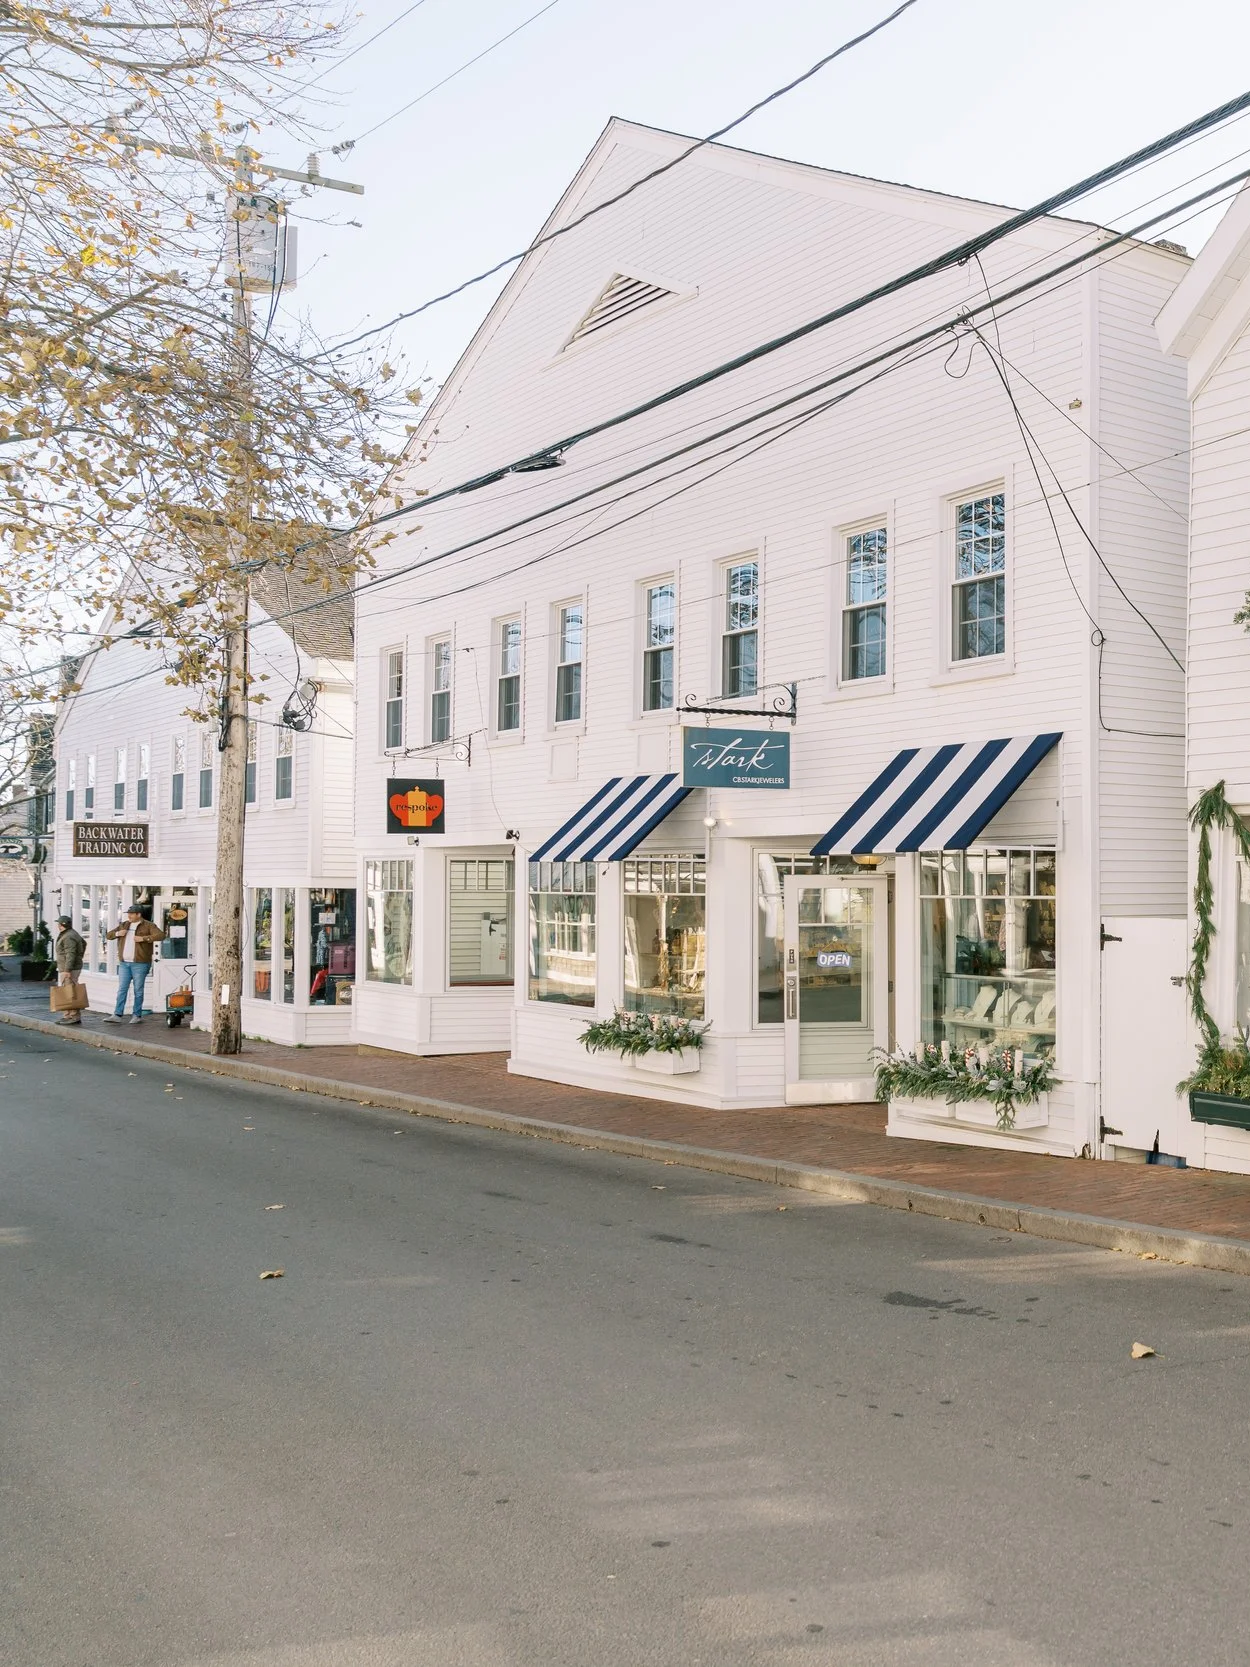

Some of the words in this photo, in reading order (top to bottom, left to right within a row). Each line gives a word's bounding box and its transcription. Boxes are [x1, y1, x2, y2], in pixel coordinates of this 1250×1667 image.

[396, 802, 438, 814] respoke
[78, 826, 144, 840] BACKWATER
[78, 841, 126, 854] TRADING
[129, 842, 146, 854] CO.
[819, 954, 851, 966] OPEN
